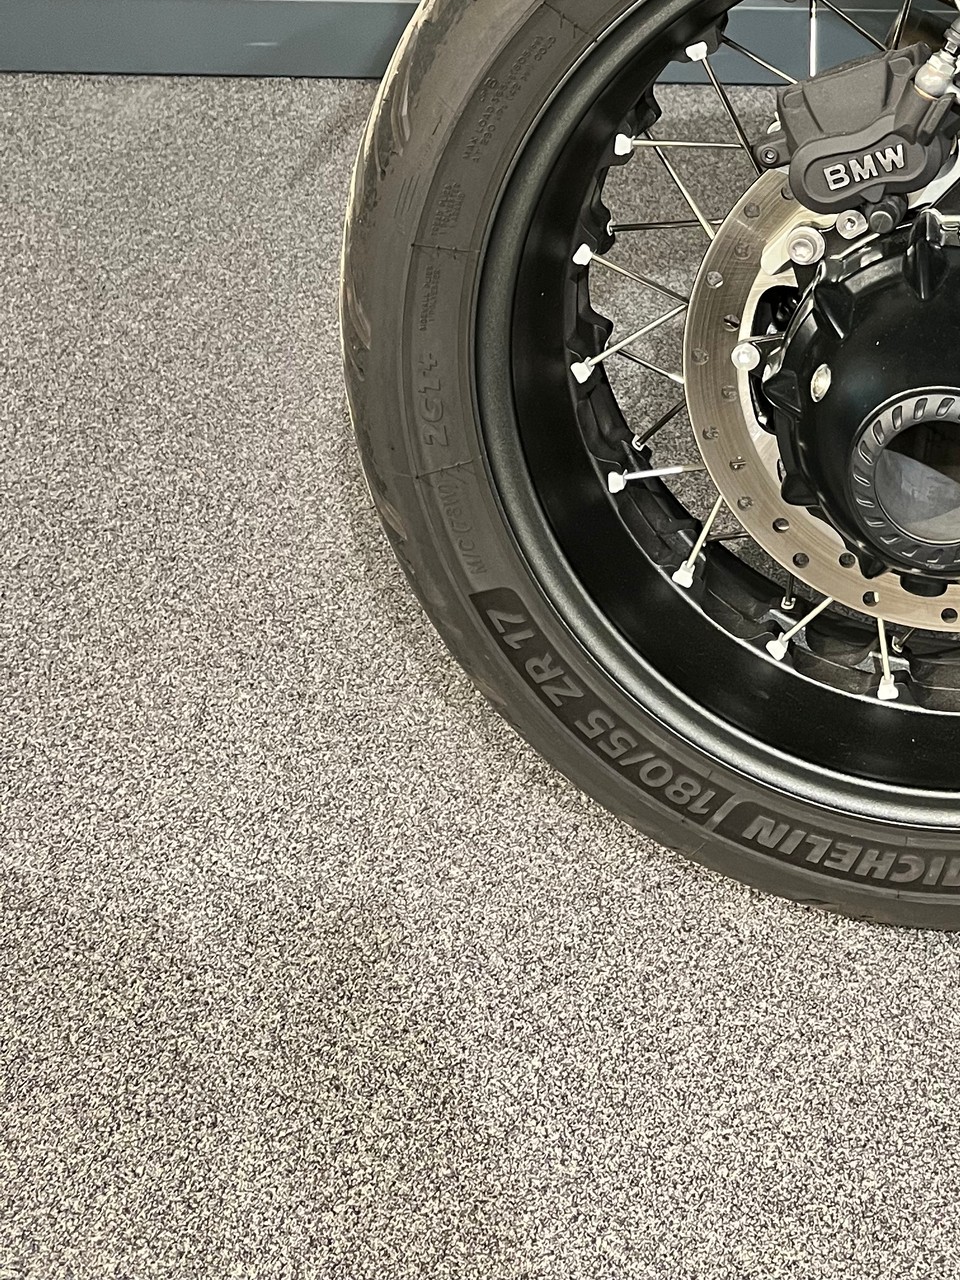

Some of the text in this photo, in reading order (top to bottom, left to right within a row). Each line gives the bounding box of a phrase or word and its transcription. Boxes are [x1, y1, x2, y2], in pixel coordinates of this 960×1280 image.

[824, 144, 905, 191] BMW
[458, 538, 487, 574] M/C
[486, 608, 534, 650] 17
[525, 652, 584, 707] ZR
[574, 709, 716, 815] 180/55
